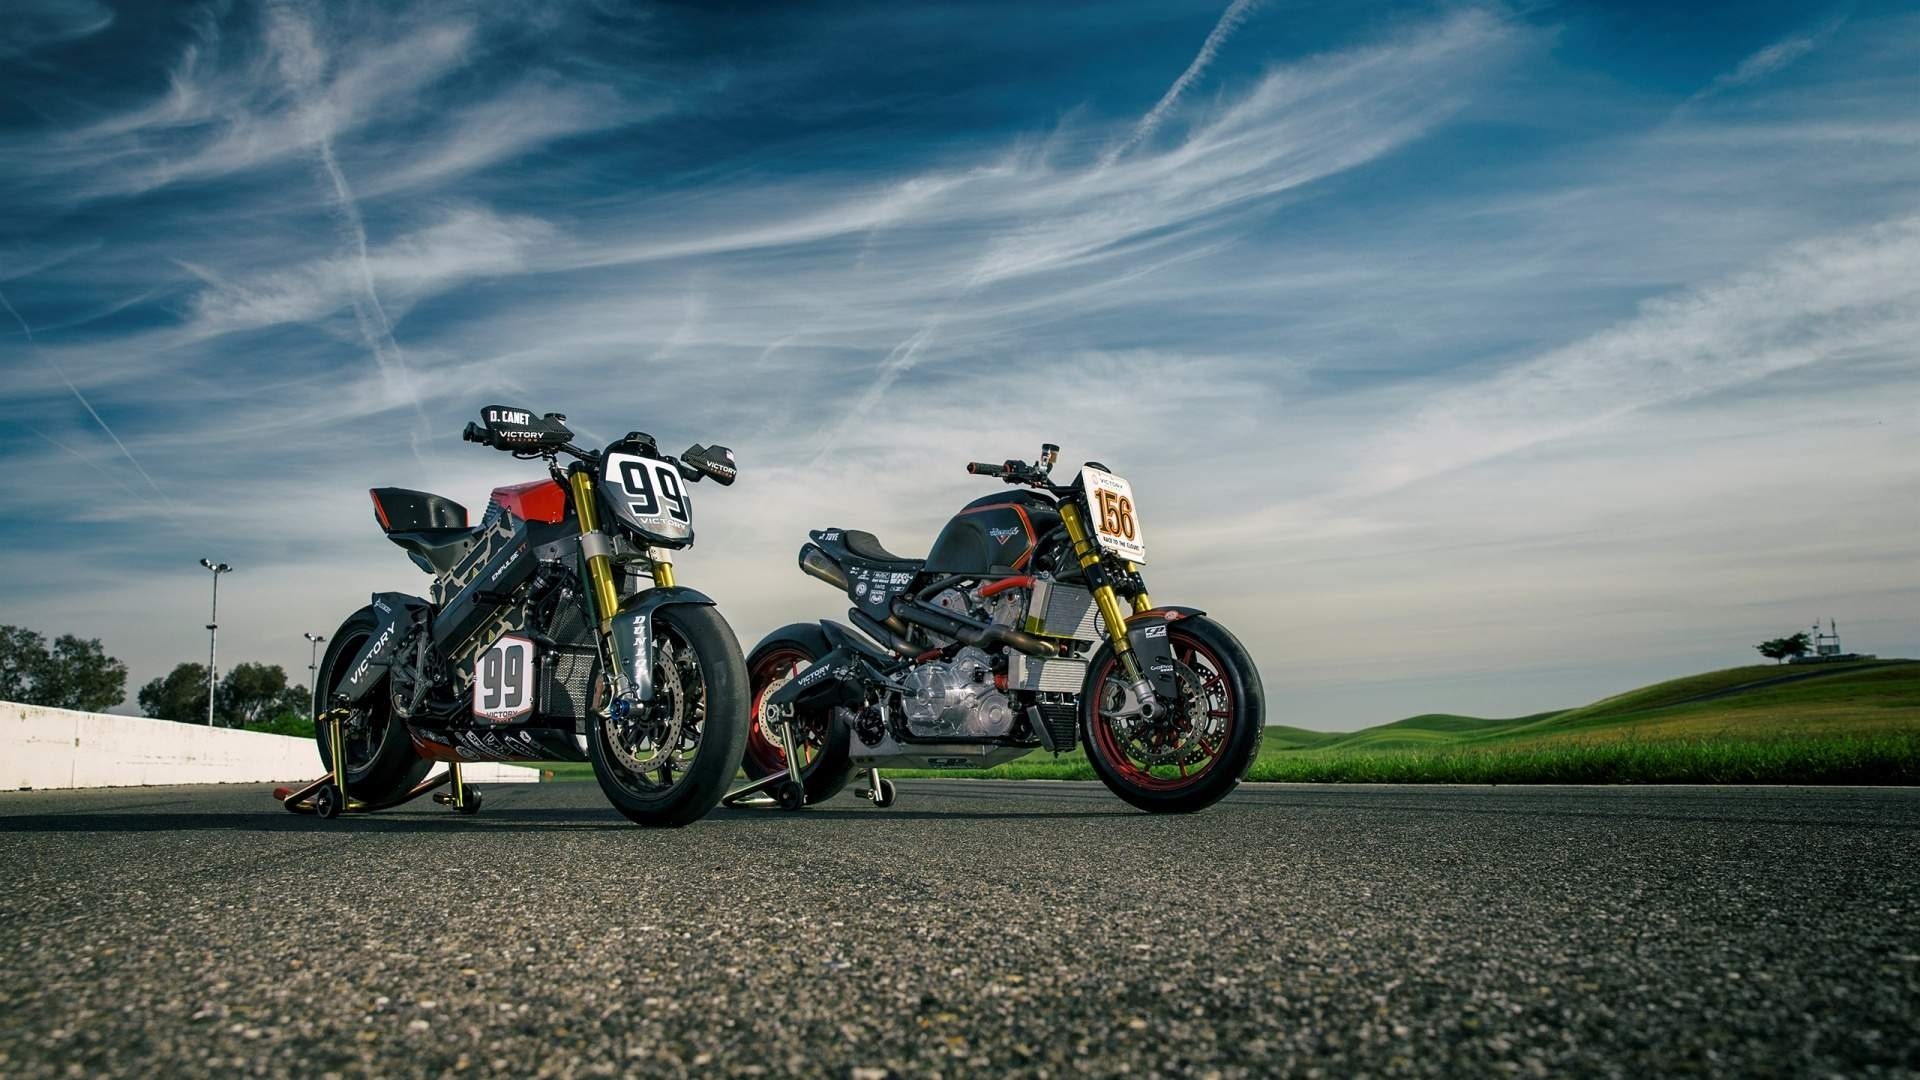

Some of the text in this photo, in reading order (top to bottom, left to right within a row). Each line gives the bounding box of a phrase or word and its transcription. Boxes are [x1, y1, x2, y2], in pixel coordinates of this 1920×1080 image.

[490, 410, 530, 426] D. CANET
[499, 430, 544, 439] VICTORY
[706, 460, 737, 475] VICTORY
[617, 459, 689, 524] 99
[640, 517, 686, 529] VICTORY
[1094, 487, 1136, 542] 156
[350, 621, 396, 685] VICTORY
[483, 645, 524, 710] 99
[798, 664, 830, 686] VICTORY
[486, 709, 518, 718] VICTORY
